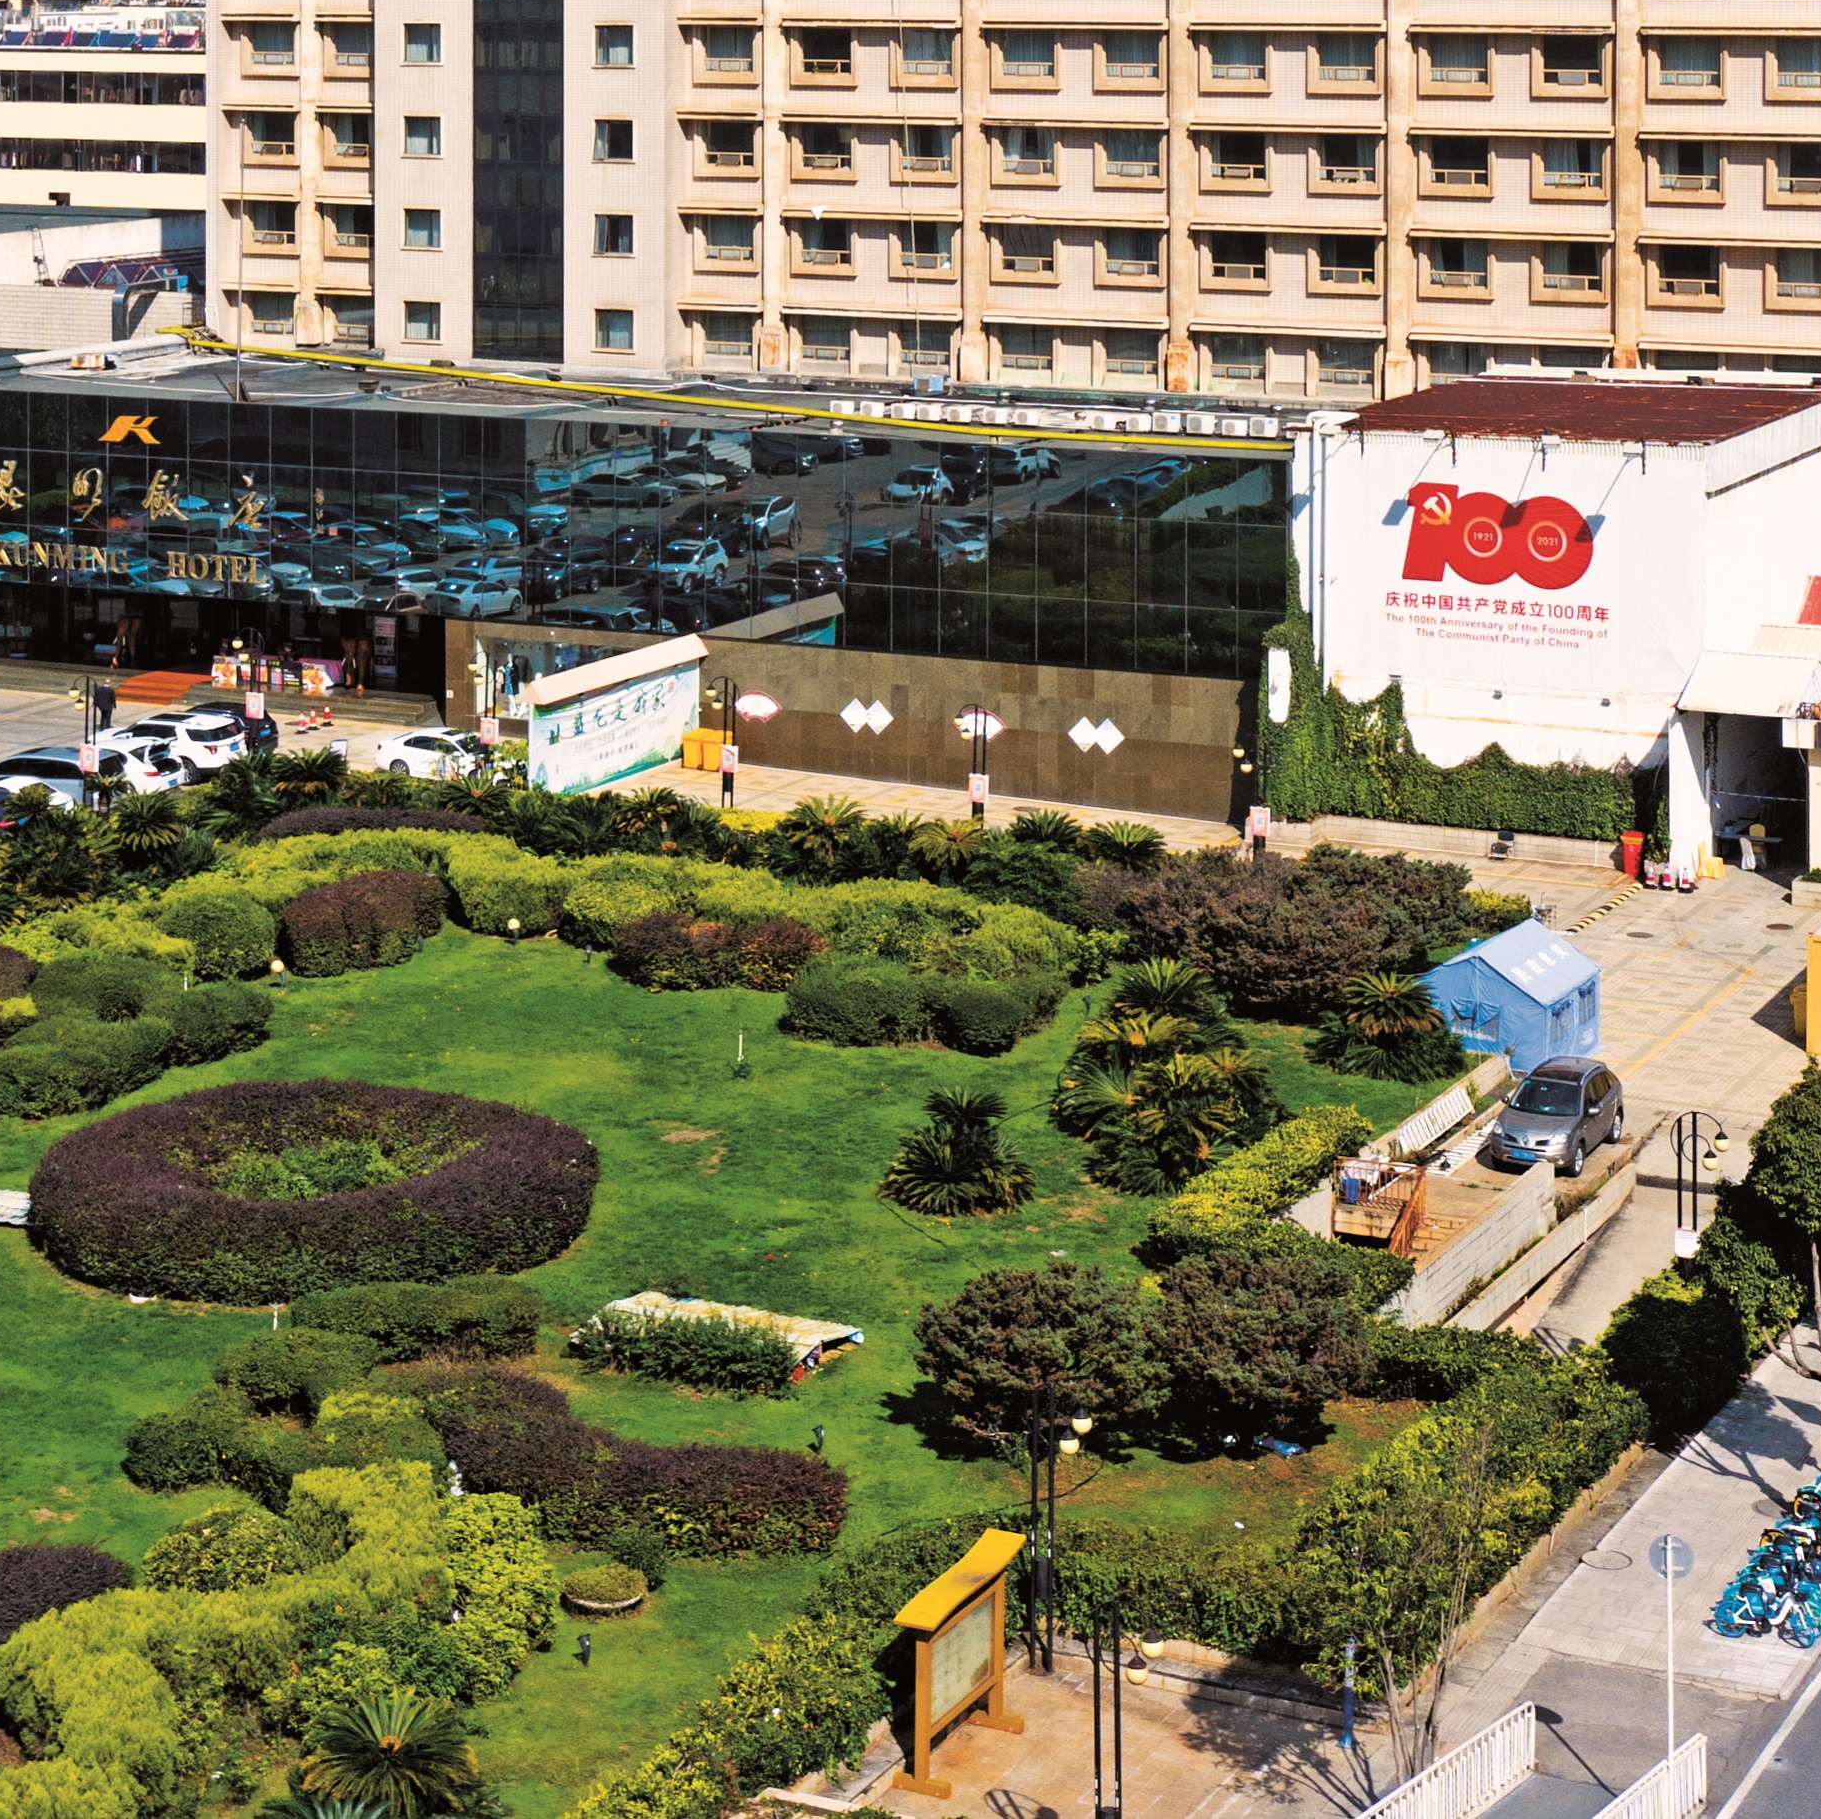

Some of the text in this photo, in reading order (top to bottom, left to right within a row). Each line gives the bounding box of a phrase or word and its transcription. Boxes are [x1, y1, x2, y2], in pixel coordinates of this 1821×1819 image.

[1402, 482, 1594, 590] 100
[1473, 531, 1494, 542] 1921
[1536, 536, 1559, 547] 2021
[166, 550, 266, 584] HOTEL
[1385, 591, 1610, 623] 庆祝中国共产党成立100周年
[1385, 613, 1608, 640] The 100th Anniversary of the Founding of
[1416, 628, 1580, 649] The Communist Party of China
